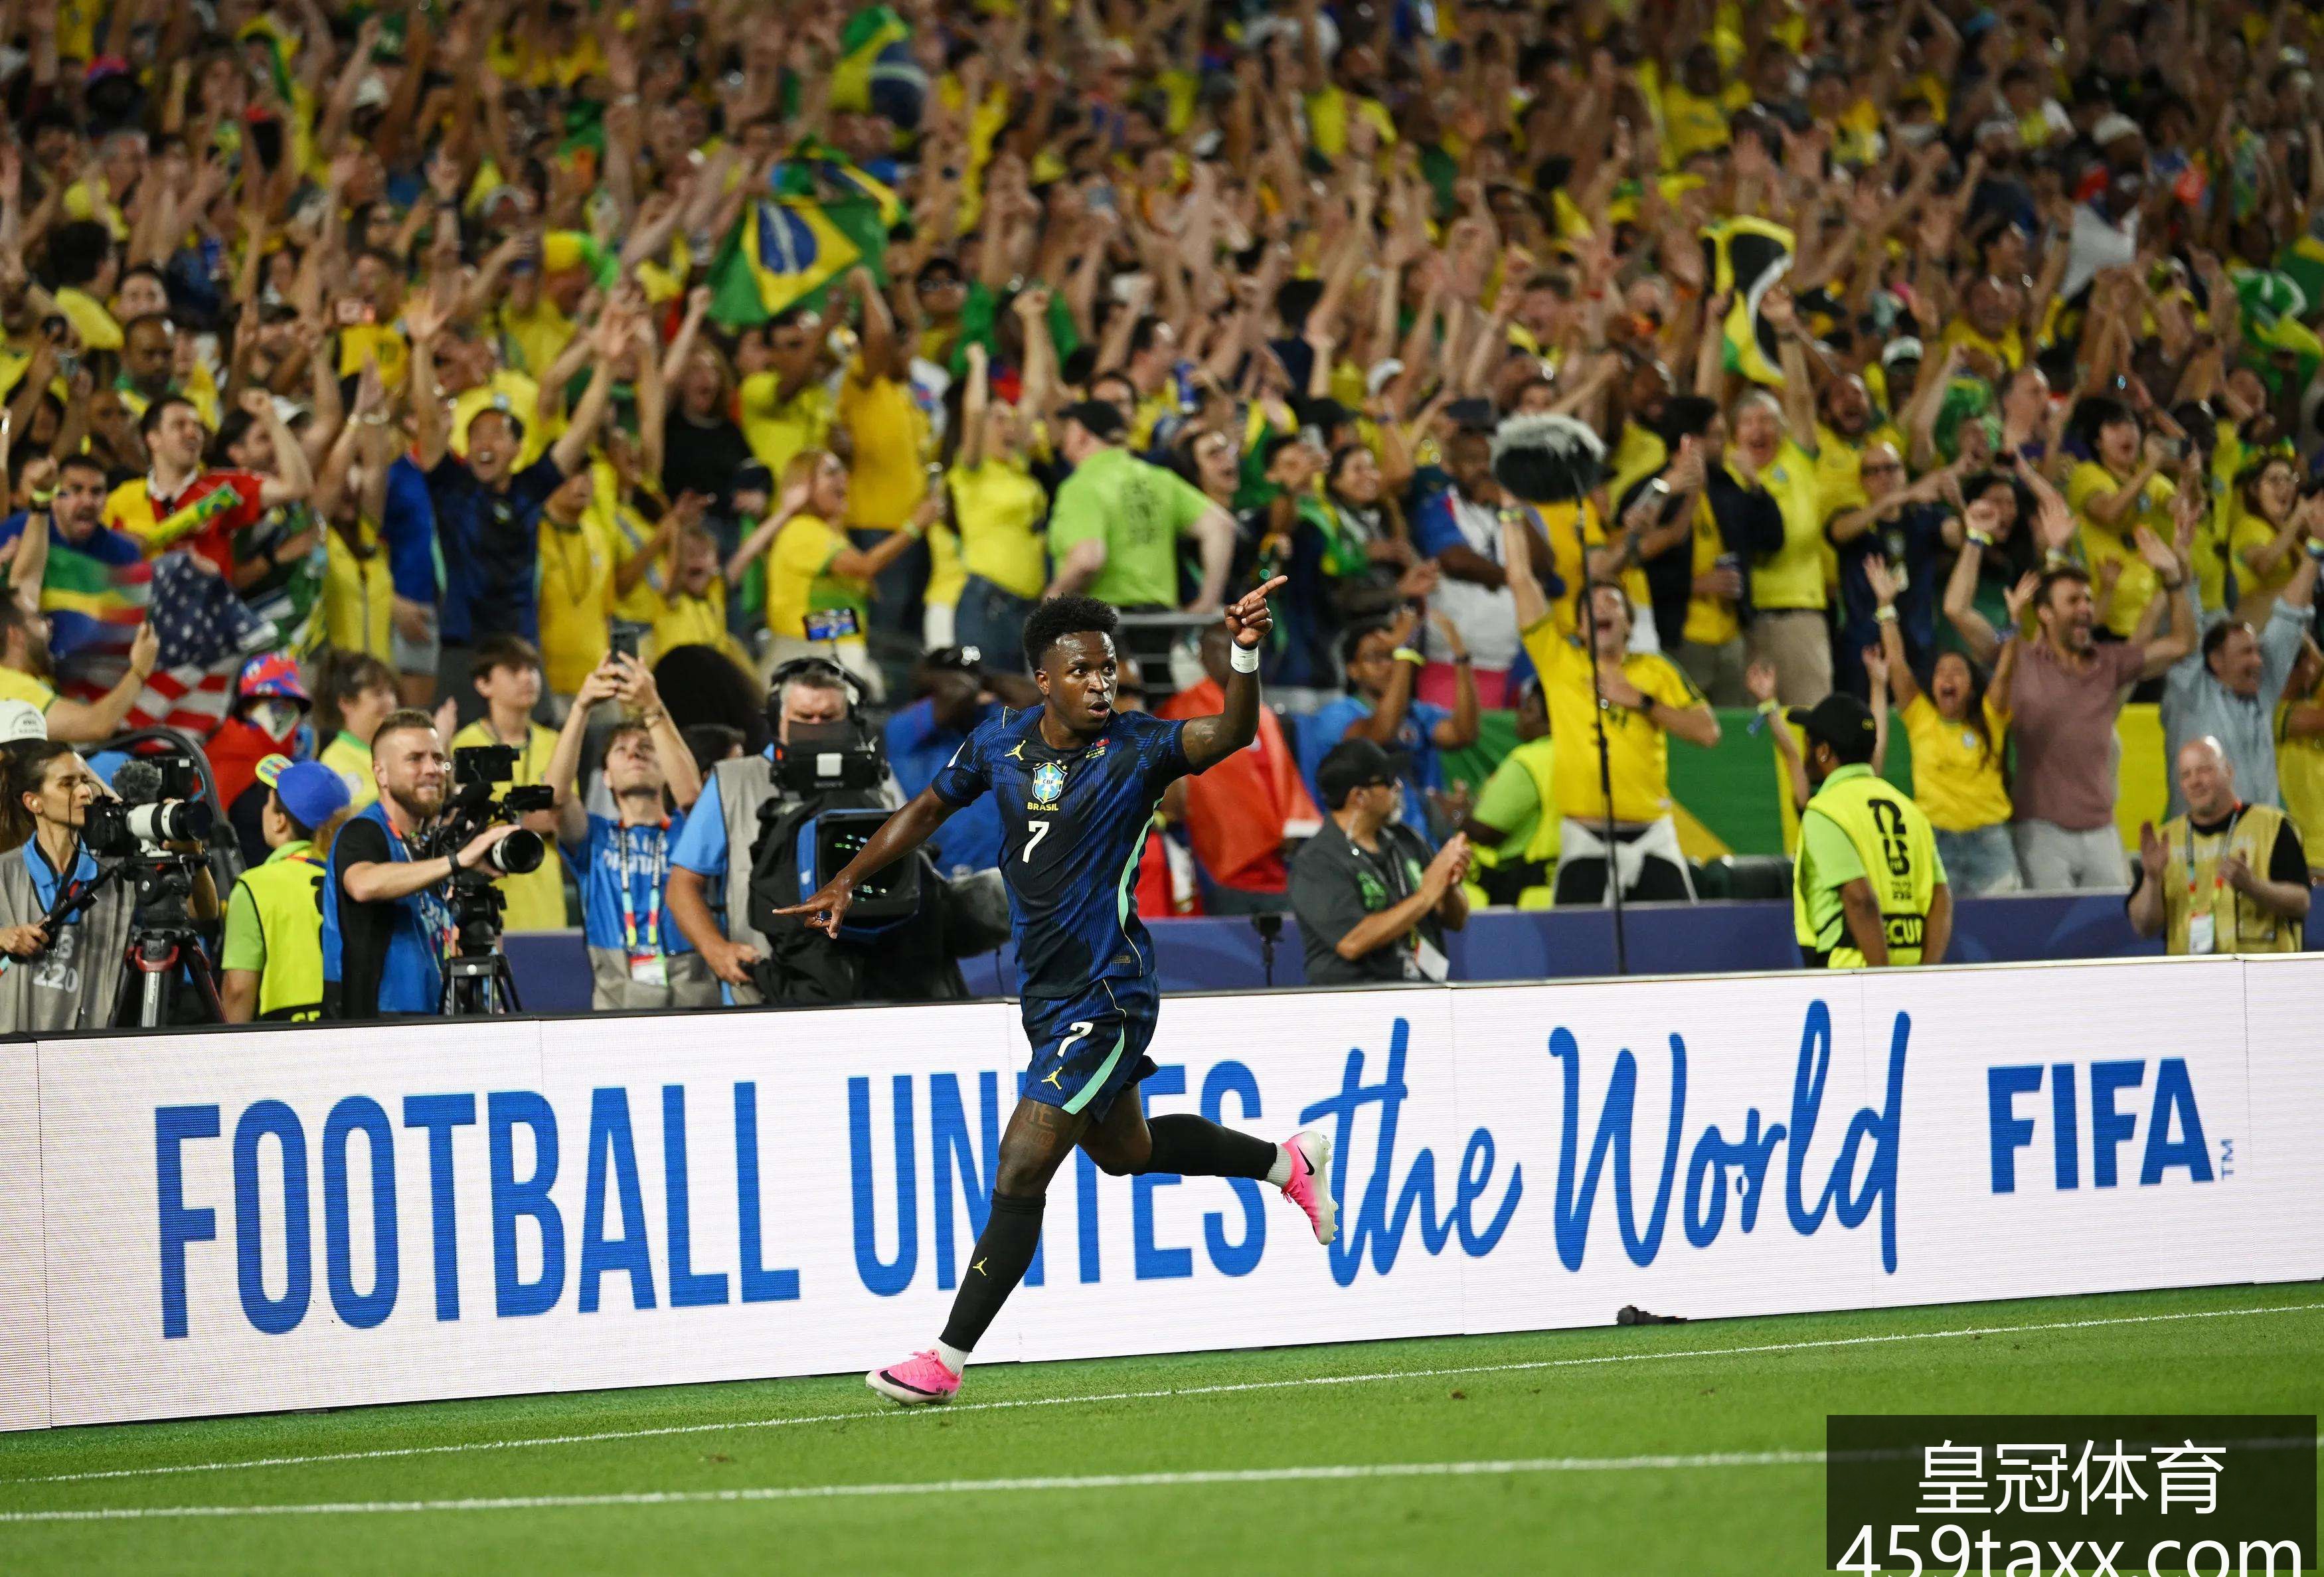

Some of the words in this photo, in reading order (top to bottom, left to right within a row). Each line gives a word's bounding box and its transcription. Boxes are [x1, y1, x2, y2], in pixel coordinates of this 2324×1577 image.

[1027, 801, 1059, 811] BRASIL
[1022, 821, 1050, 863] 7
[33, 961, 78, 993] 220
[1057, 1021, 1094, 1057] 7
[155, 1081, 800, 1339] FOOTBALL
[1299, 1017, 1523, 1288] the
[1548, 999, 1911, 1274] World
[1987, 1057, 2214, 1195] FIFA
[2220, 1138, 2234, 1180] TM
